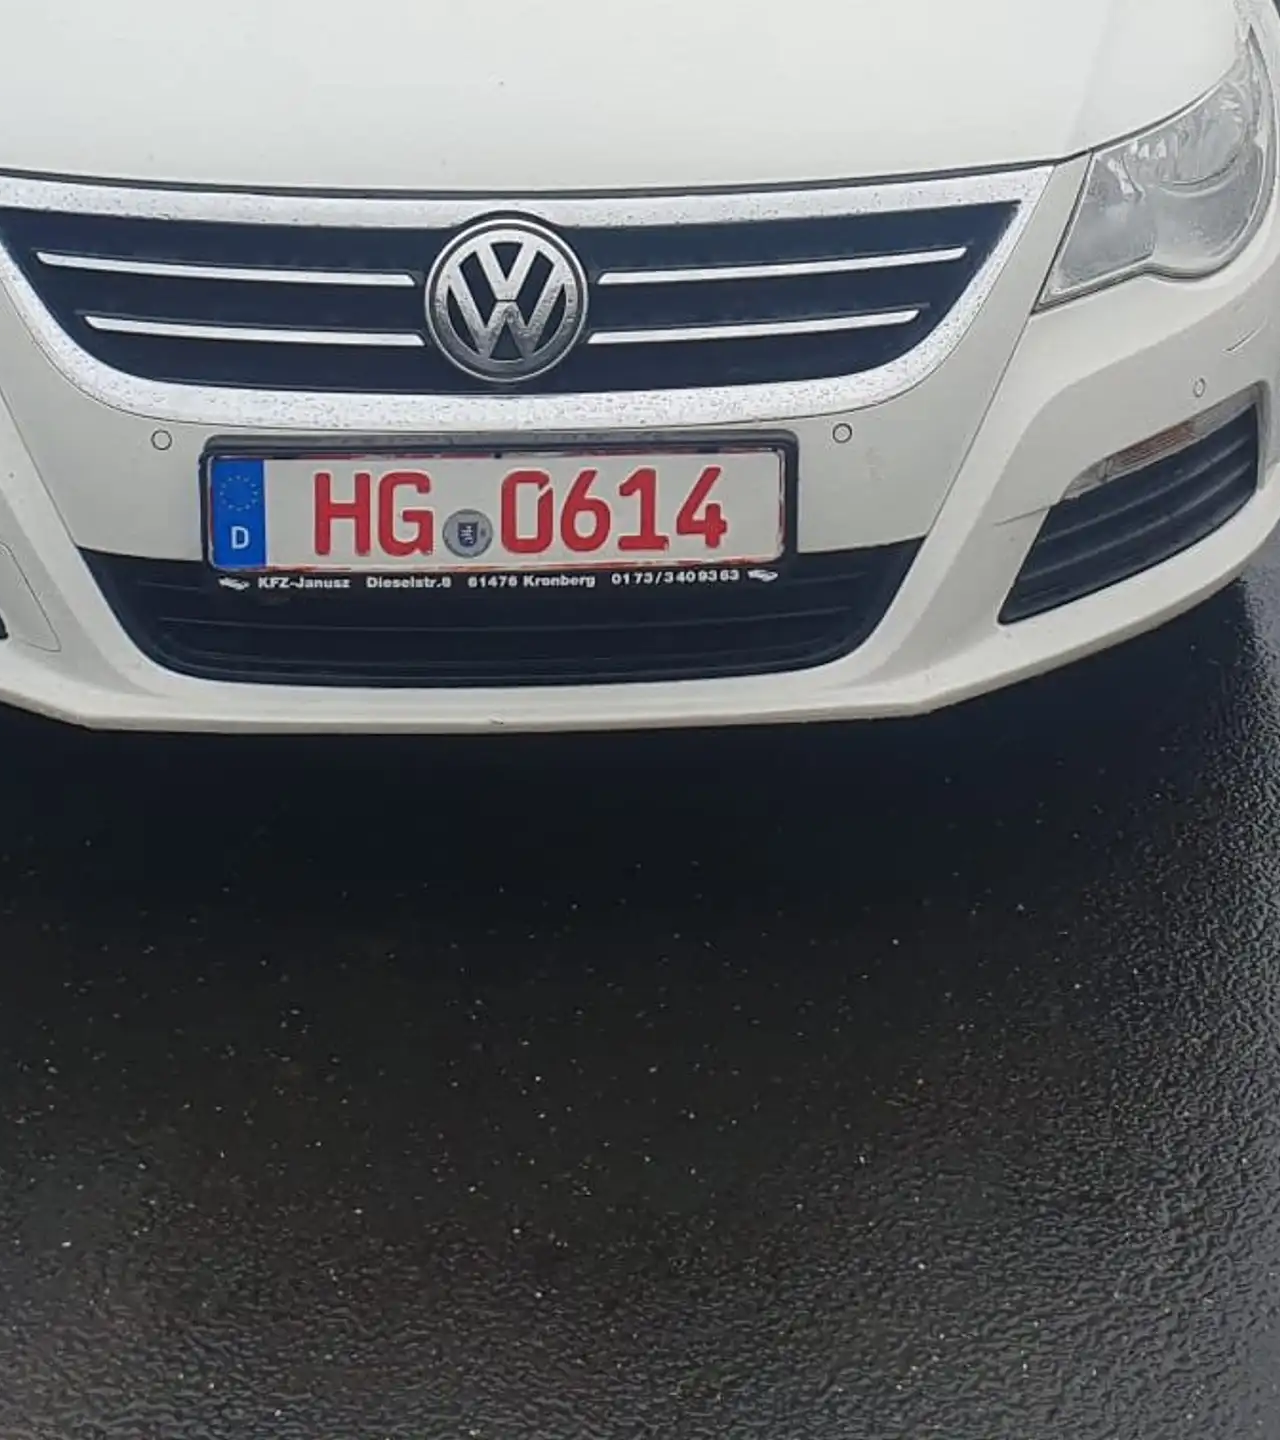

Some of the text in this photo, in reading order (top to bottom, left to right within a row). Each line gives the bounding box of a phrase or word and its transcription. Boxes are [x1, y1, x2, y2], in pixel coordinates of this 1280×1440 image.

[425, 218, 588, 382] VW
[231, 526, 250, 550] D
[314, 466, 728, 557] HG 0614
[257, 576, 351, 589] KFZ-Janusz
[523, 574, 596, 589] Kronberg
